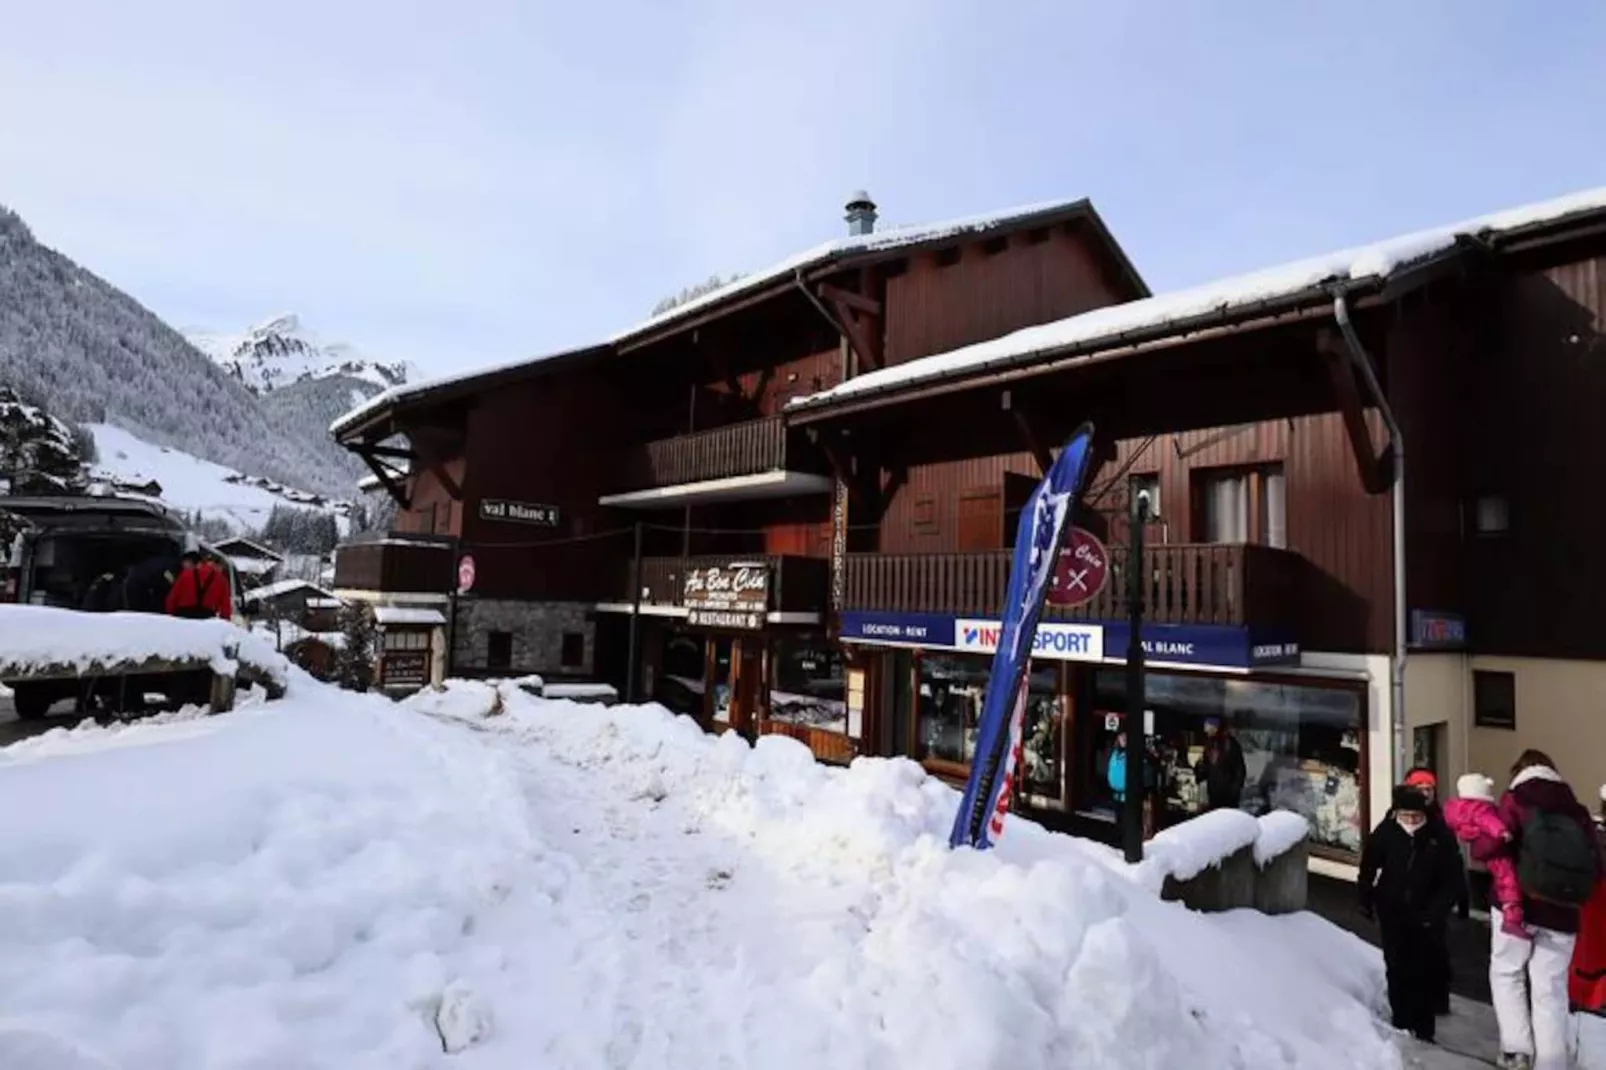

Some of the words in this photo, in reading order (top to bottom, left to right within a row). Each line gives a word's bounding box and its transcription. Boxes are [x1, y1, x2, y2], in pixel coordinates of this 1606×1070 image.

[484, 503, 505, 516] val
[706, 567, 730, 591] Bon
[699, 613, 747, 627] RESTAURANT
[862, 624, 900, 635] LOCATION
[906, 626, 927, 637] RENT
[1141, 641, 1153, 652] AL
[1156, 641, 1194, 654] BLANC
